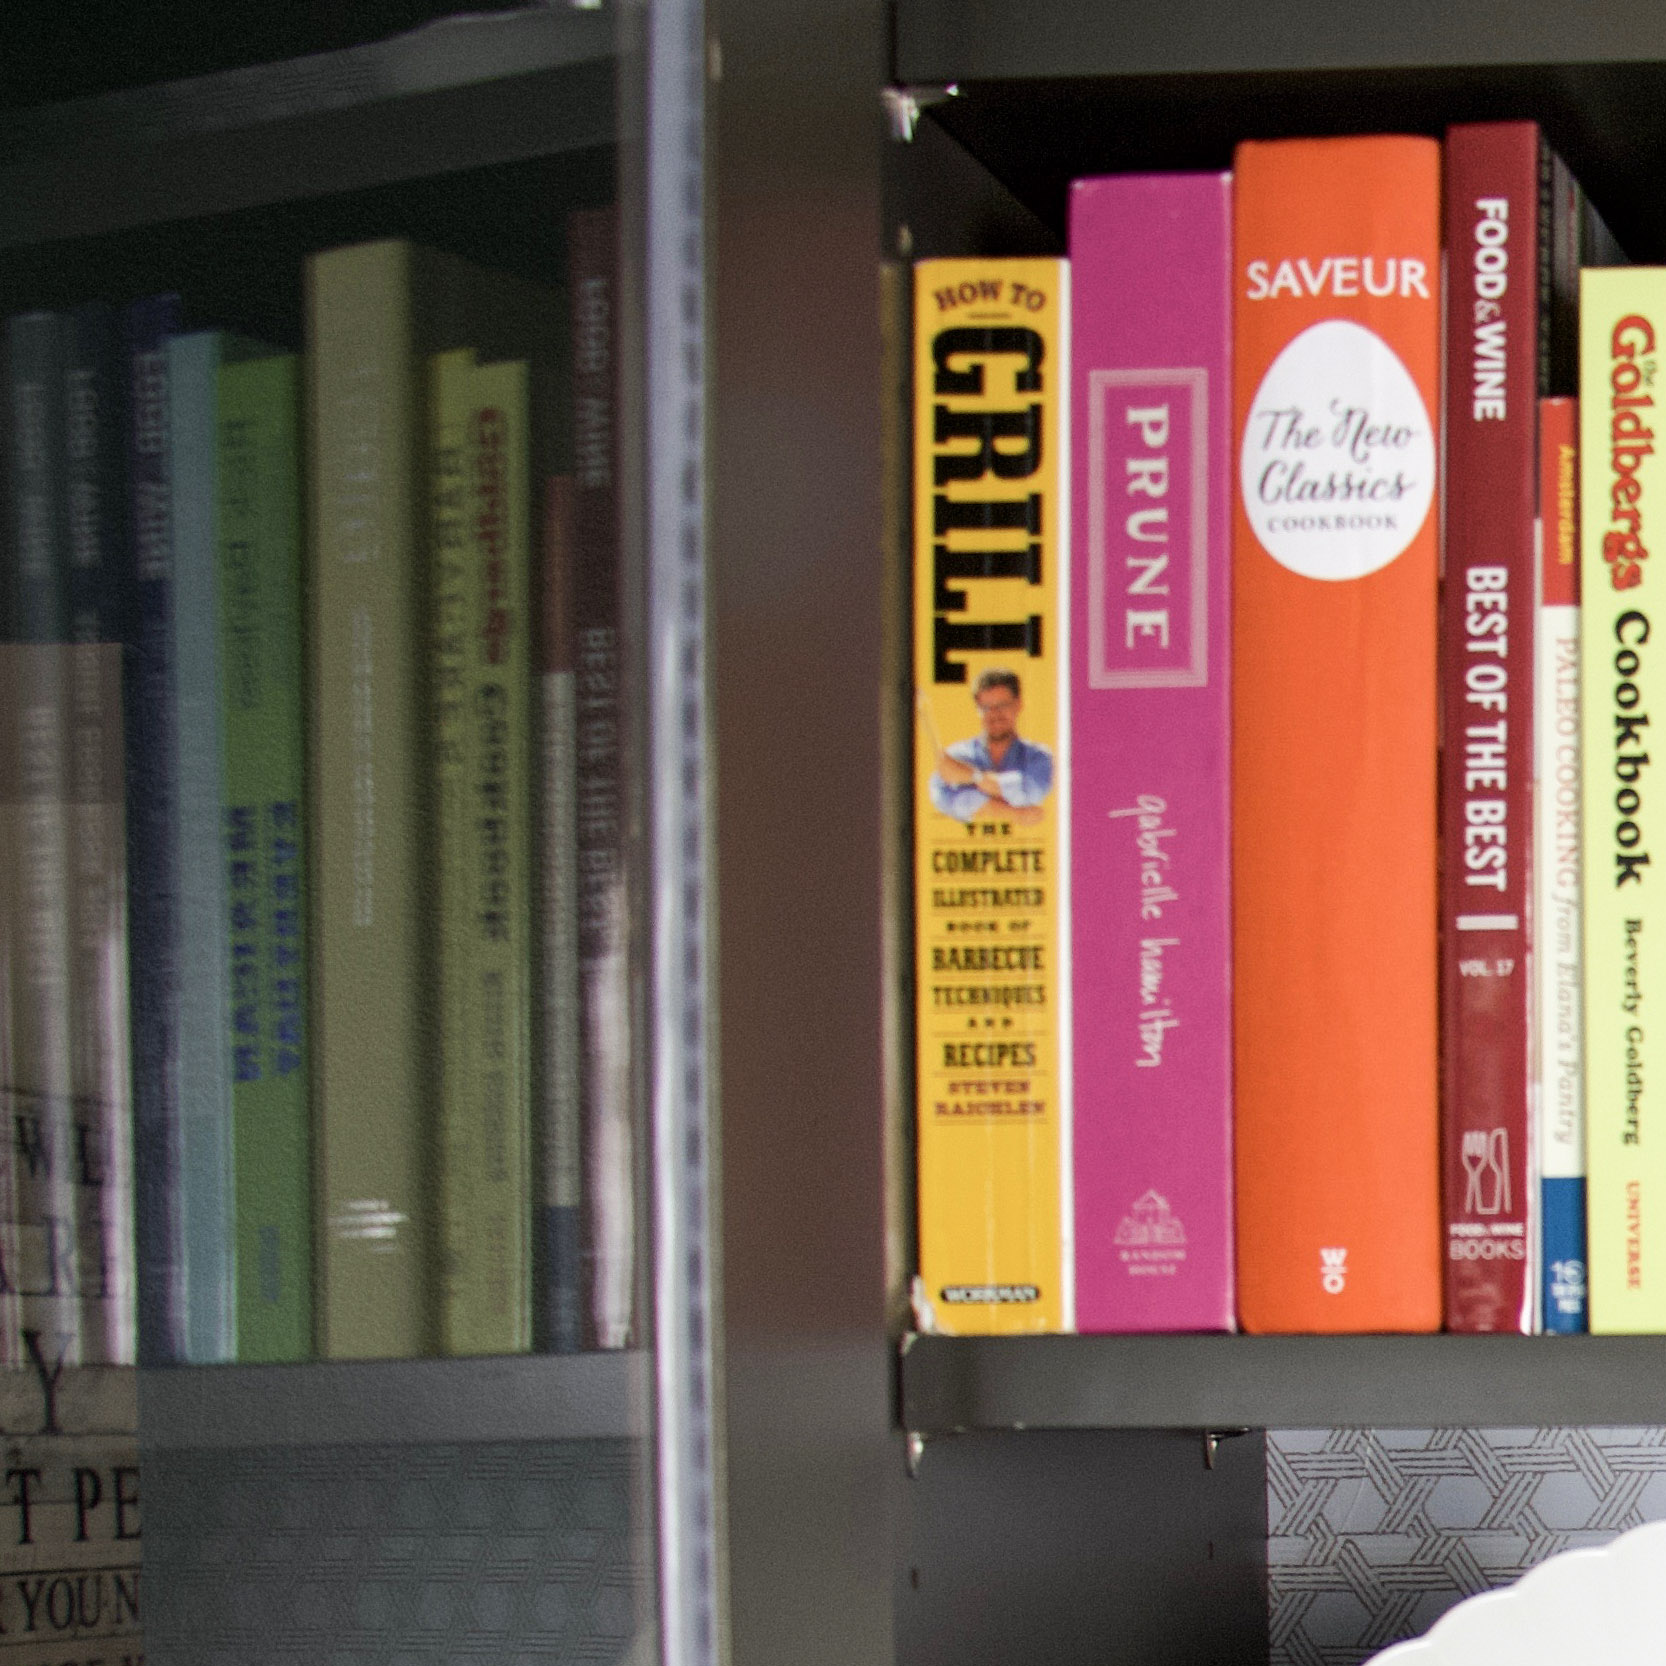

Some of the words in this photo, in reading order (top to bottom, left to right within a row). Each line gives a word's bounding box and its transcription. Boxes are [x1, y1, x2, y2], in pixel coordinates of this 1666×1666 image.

[935, 280, 1001, 312] HOW
[1010, 279, 1047, 312] TO
[1246, 258, 1430, 301] SAVEUR
[1471, 198, 1509, 421] FOOD&WINE
[1256, 407, 1323, 452] The
[1331, 398, 1417, 461] New
[1600, 313, 1656, 592] Goldbergs
[932, 324, 1047, 685] GRILL
[1257, 460, 1418, 507] Classics
[1266, 513, 1399, 532] COOKBOOK
[1557, 444, 1575, 566] Amsterdam
[1125, 403, 1170, 649] PRUNE
[1465, 565, 1508, 656] BEST
[1465, 666, 1507, 711] OF
[1555, 637, 1578, 738] PALEO
[1465, 722, 1507, 791] THE
[1613, 609, 1652, 889] Cookbook
[966, 822, 1012, 836] THE
[1464, 799, 1506, 891] BEST
[1555, 744, 1579, 888] COOKING
[931, 849, 1044, 873] COMPLETE
[1110, 794, 1178, 921] gabrielle
[931, 888, 1045, 908] ILLUSTRATED
[1552, 893, 1578, 957] from
[931, 946, 1044, 971] BARBECUE
[931, 984, 1047, 1009] TECHNIQUES
[1623, 917, 1641, 1015] Beverly
[1135, 937, 1180, 1069] hamilton
[1556, 960, 1579, 1050] Elana's
[942, 1042, 1036, 1067] RECIPES
[948, 1080, 1031, 1095] STEVEN
[1623, 1025, 1644, 1147] Goldberg
[935, 1101, 1046, 1117] RAICHLEN
[1552, 1058, 1578, 1146] Pantry
[1449, 1238, 1526, 1261] BOOKS
[1625, 1180, 1642, 1290] UNIVERSE
